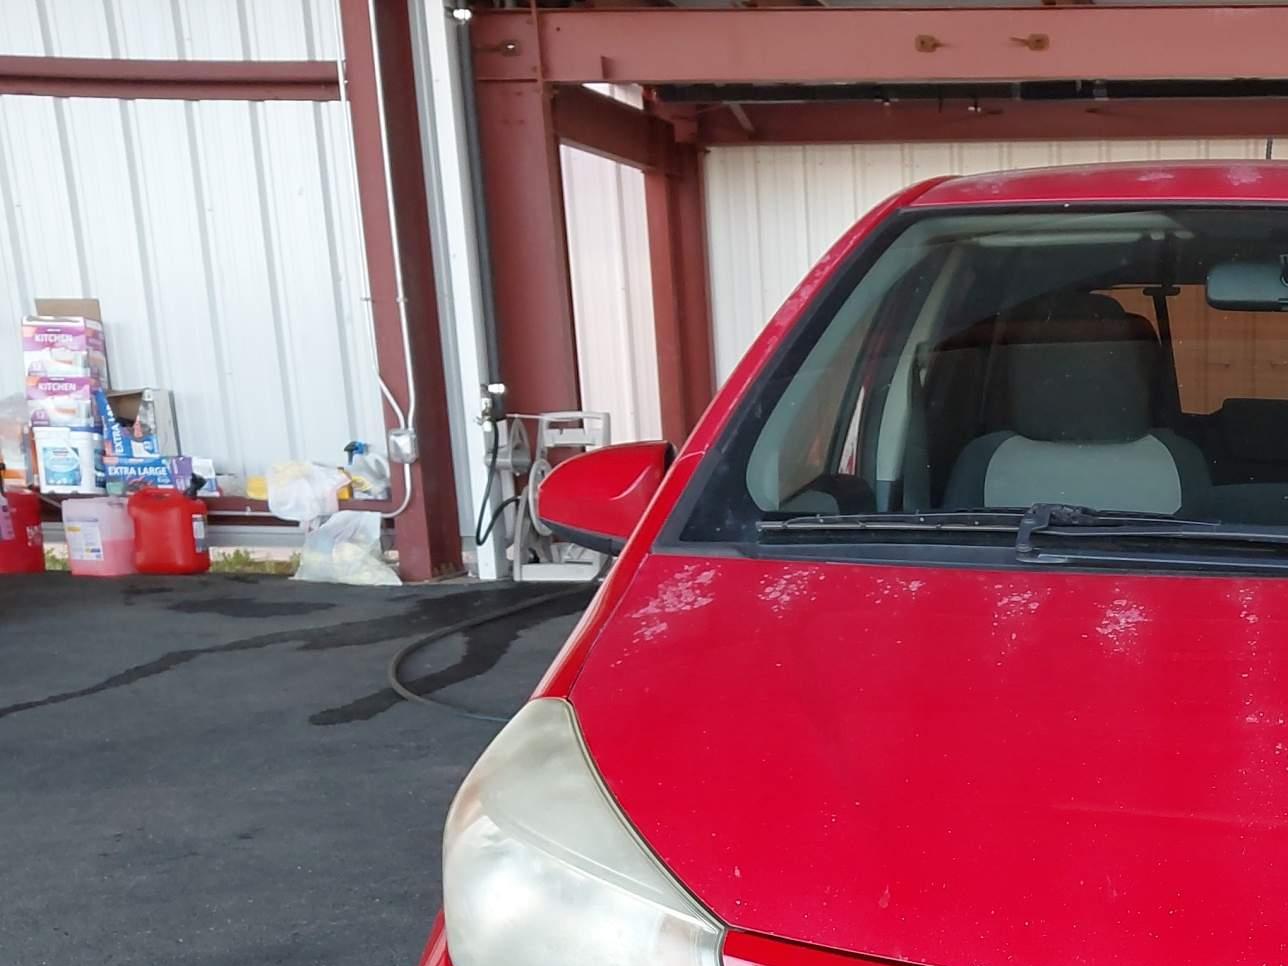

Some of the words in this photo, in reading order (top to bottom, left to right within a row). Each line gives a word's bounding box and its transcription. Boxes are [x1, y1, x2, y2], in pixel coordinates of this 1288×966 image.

[34, 334, 73, 343] KITCHEN
[38, 383, 77, 391] KITCHEN
[111, 423, 124, 453] EXTRA
[108, 466, 136, 476] EXTRA
[138, 466, 168, 476] LARGE
